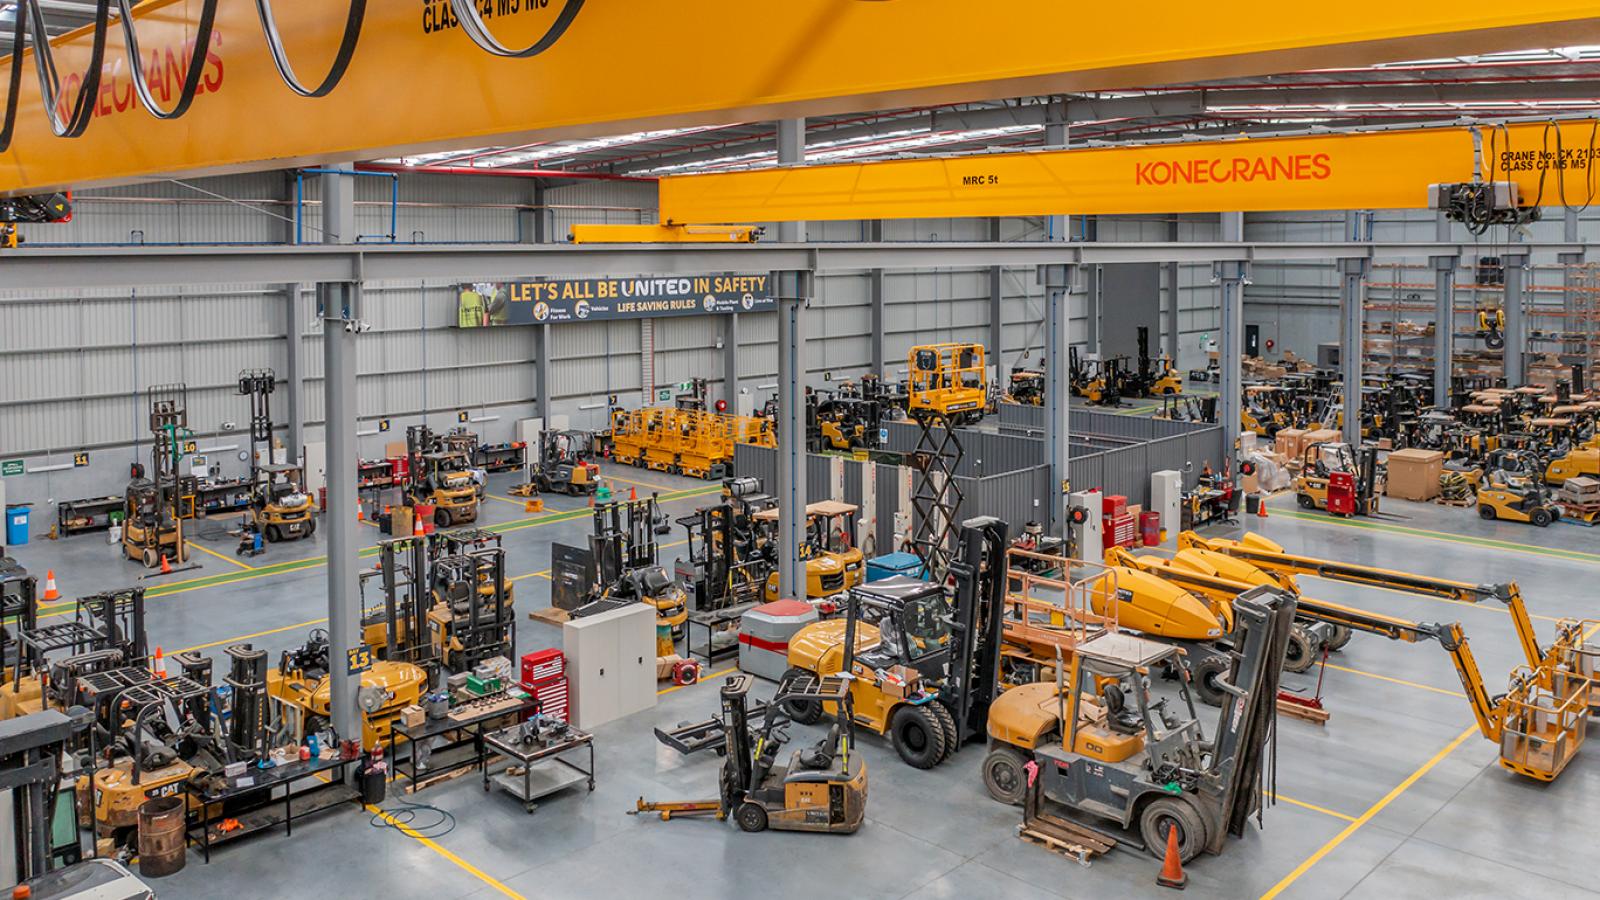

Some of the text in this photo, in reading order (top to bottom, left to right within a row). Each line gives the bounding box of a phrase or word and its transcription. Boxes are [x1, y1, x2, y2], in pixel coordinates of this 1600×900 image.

[423, 2, 459, 34] CLAS
[1501, 151, 1535, 161] CRANE
[1559, 149, 1573, 159] CK
[1136, 153, 1331, 186] KONECRANES
[1501, 161, 1533, 171] CLASS
[1571, 159, 1586, 169] M5
[963, 174, 998, 186] MRC 5t
[511, 276, 766, 302] LET'S ALL BE UNITED IN SAFETY
[617, 299, 696, 313] LIFE SAVING RULES
[184, 443, 196, 453] 10
[75, 455, 88, 465] 11
[349, 651, 370, 671] 13
[161, 782, 180, 798] CAT
